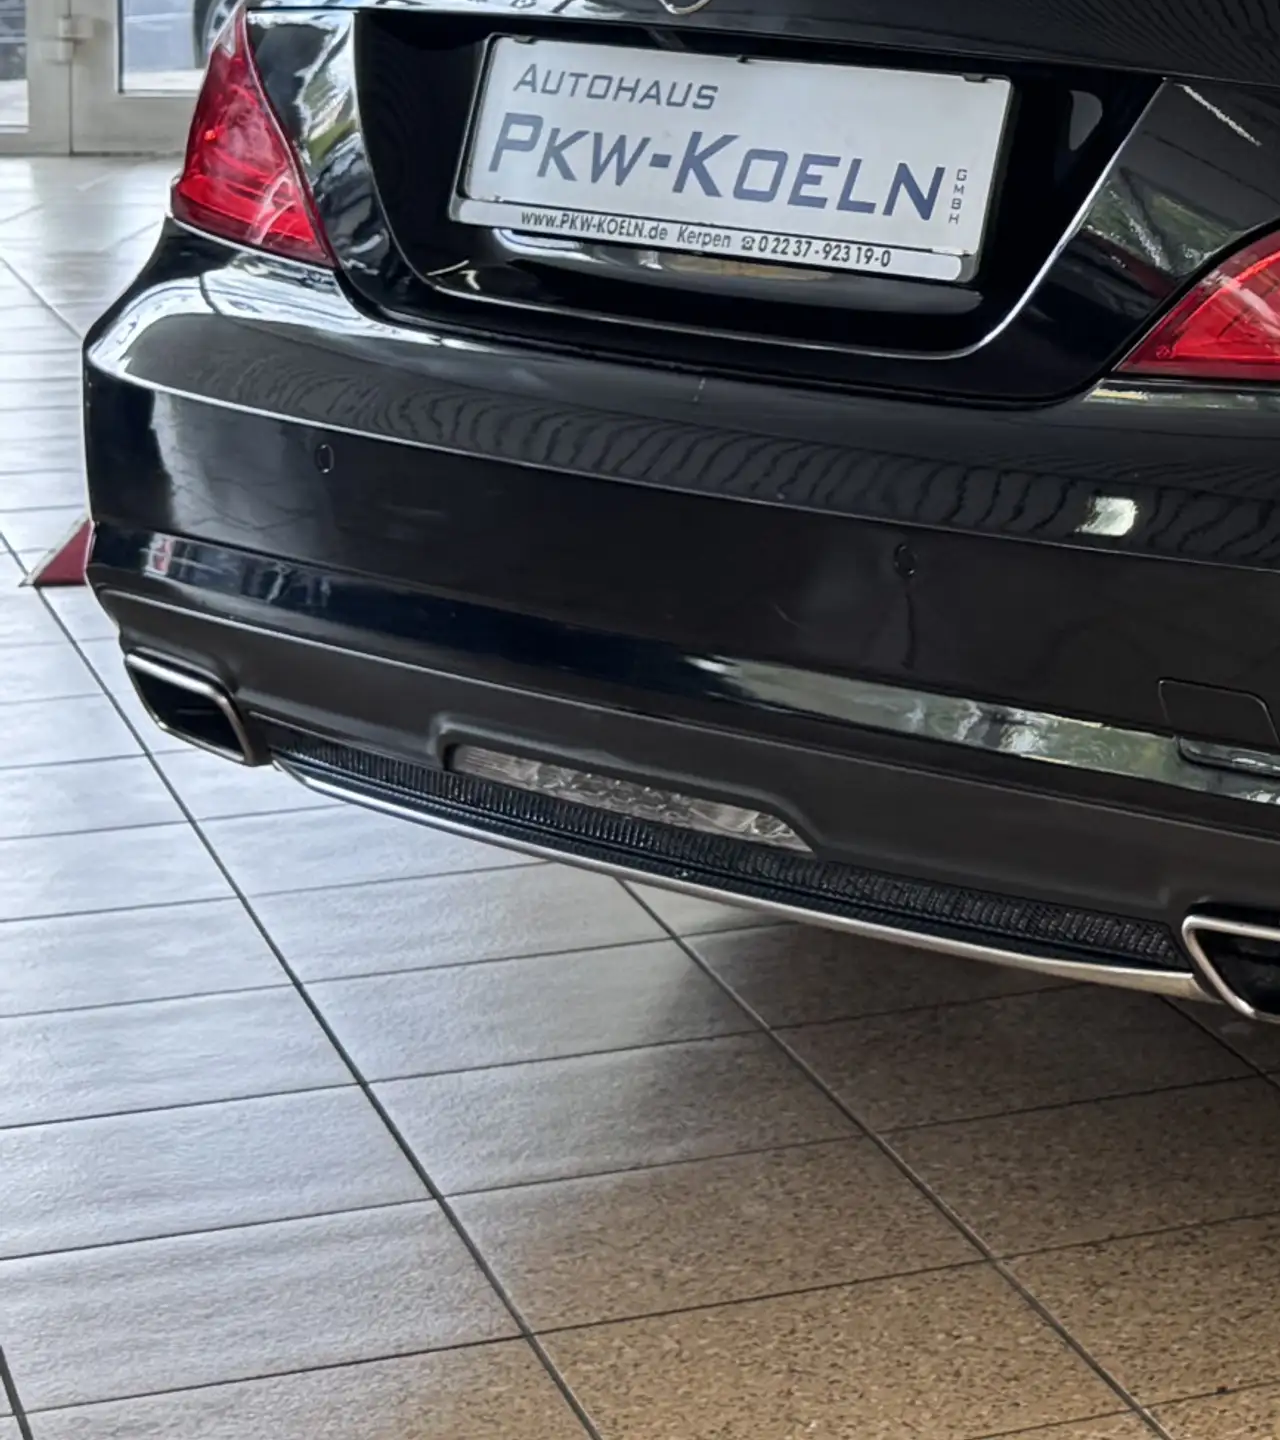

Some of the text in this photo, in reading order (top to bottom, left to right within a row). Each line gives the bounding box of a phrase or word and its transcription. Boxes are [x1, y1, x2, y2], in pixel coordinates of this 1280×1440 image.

[513, 63, 719, 110] AUTOHAUS
[488, 112, 945, 222] PKW-KOELN
[521, 211, 668, 242] www.PKW-KOELN.de
[677, 226, 732, 249] Kerpen
